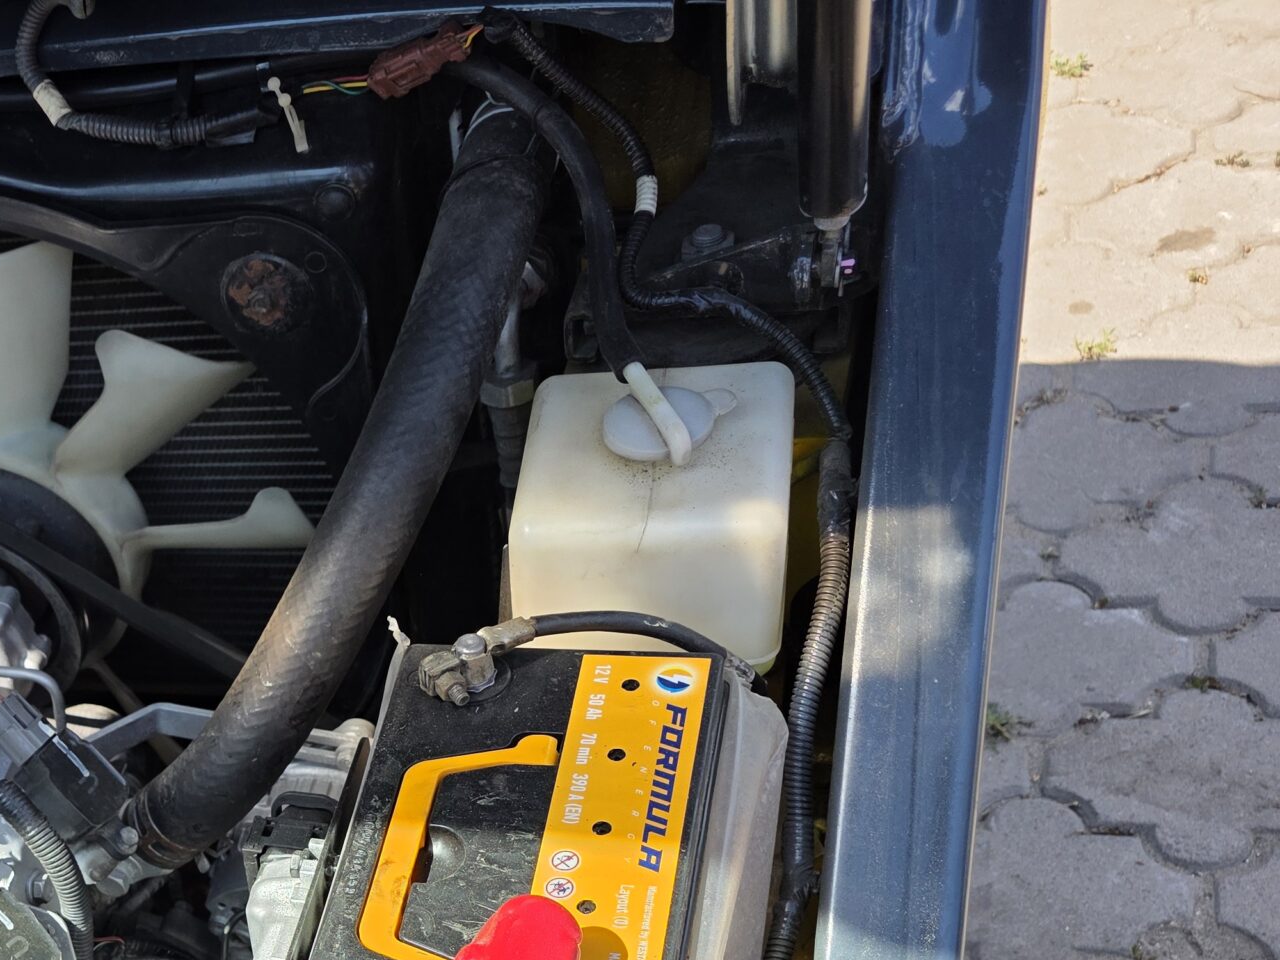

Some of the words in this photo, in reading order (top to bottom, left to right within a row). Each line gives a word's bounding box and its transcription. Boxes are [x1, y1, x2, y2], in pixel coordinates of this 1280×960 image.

[595, 665, 611, 674] 12
[589, 694, 606, 705] 50
[586, 708, 602, 720] Ah
[580, 734, 597, 744] 70
[576, 748, 592, 764] min
[570, 774, 588, 791] 390
[638, 704, 688, 872] FORMULA
[562, 804, 582, 823] (EN)
[616, 885, 634, 912] Layout
